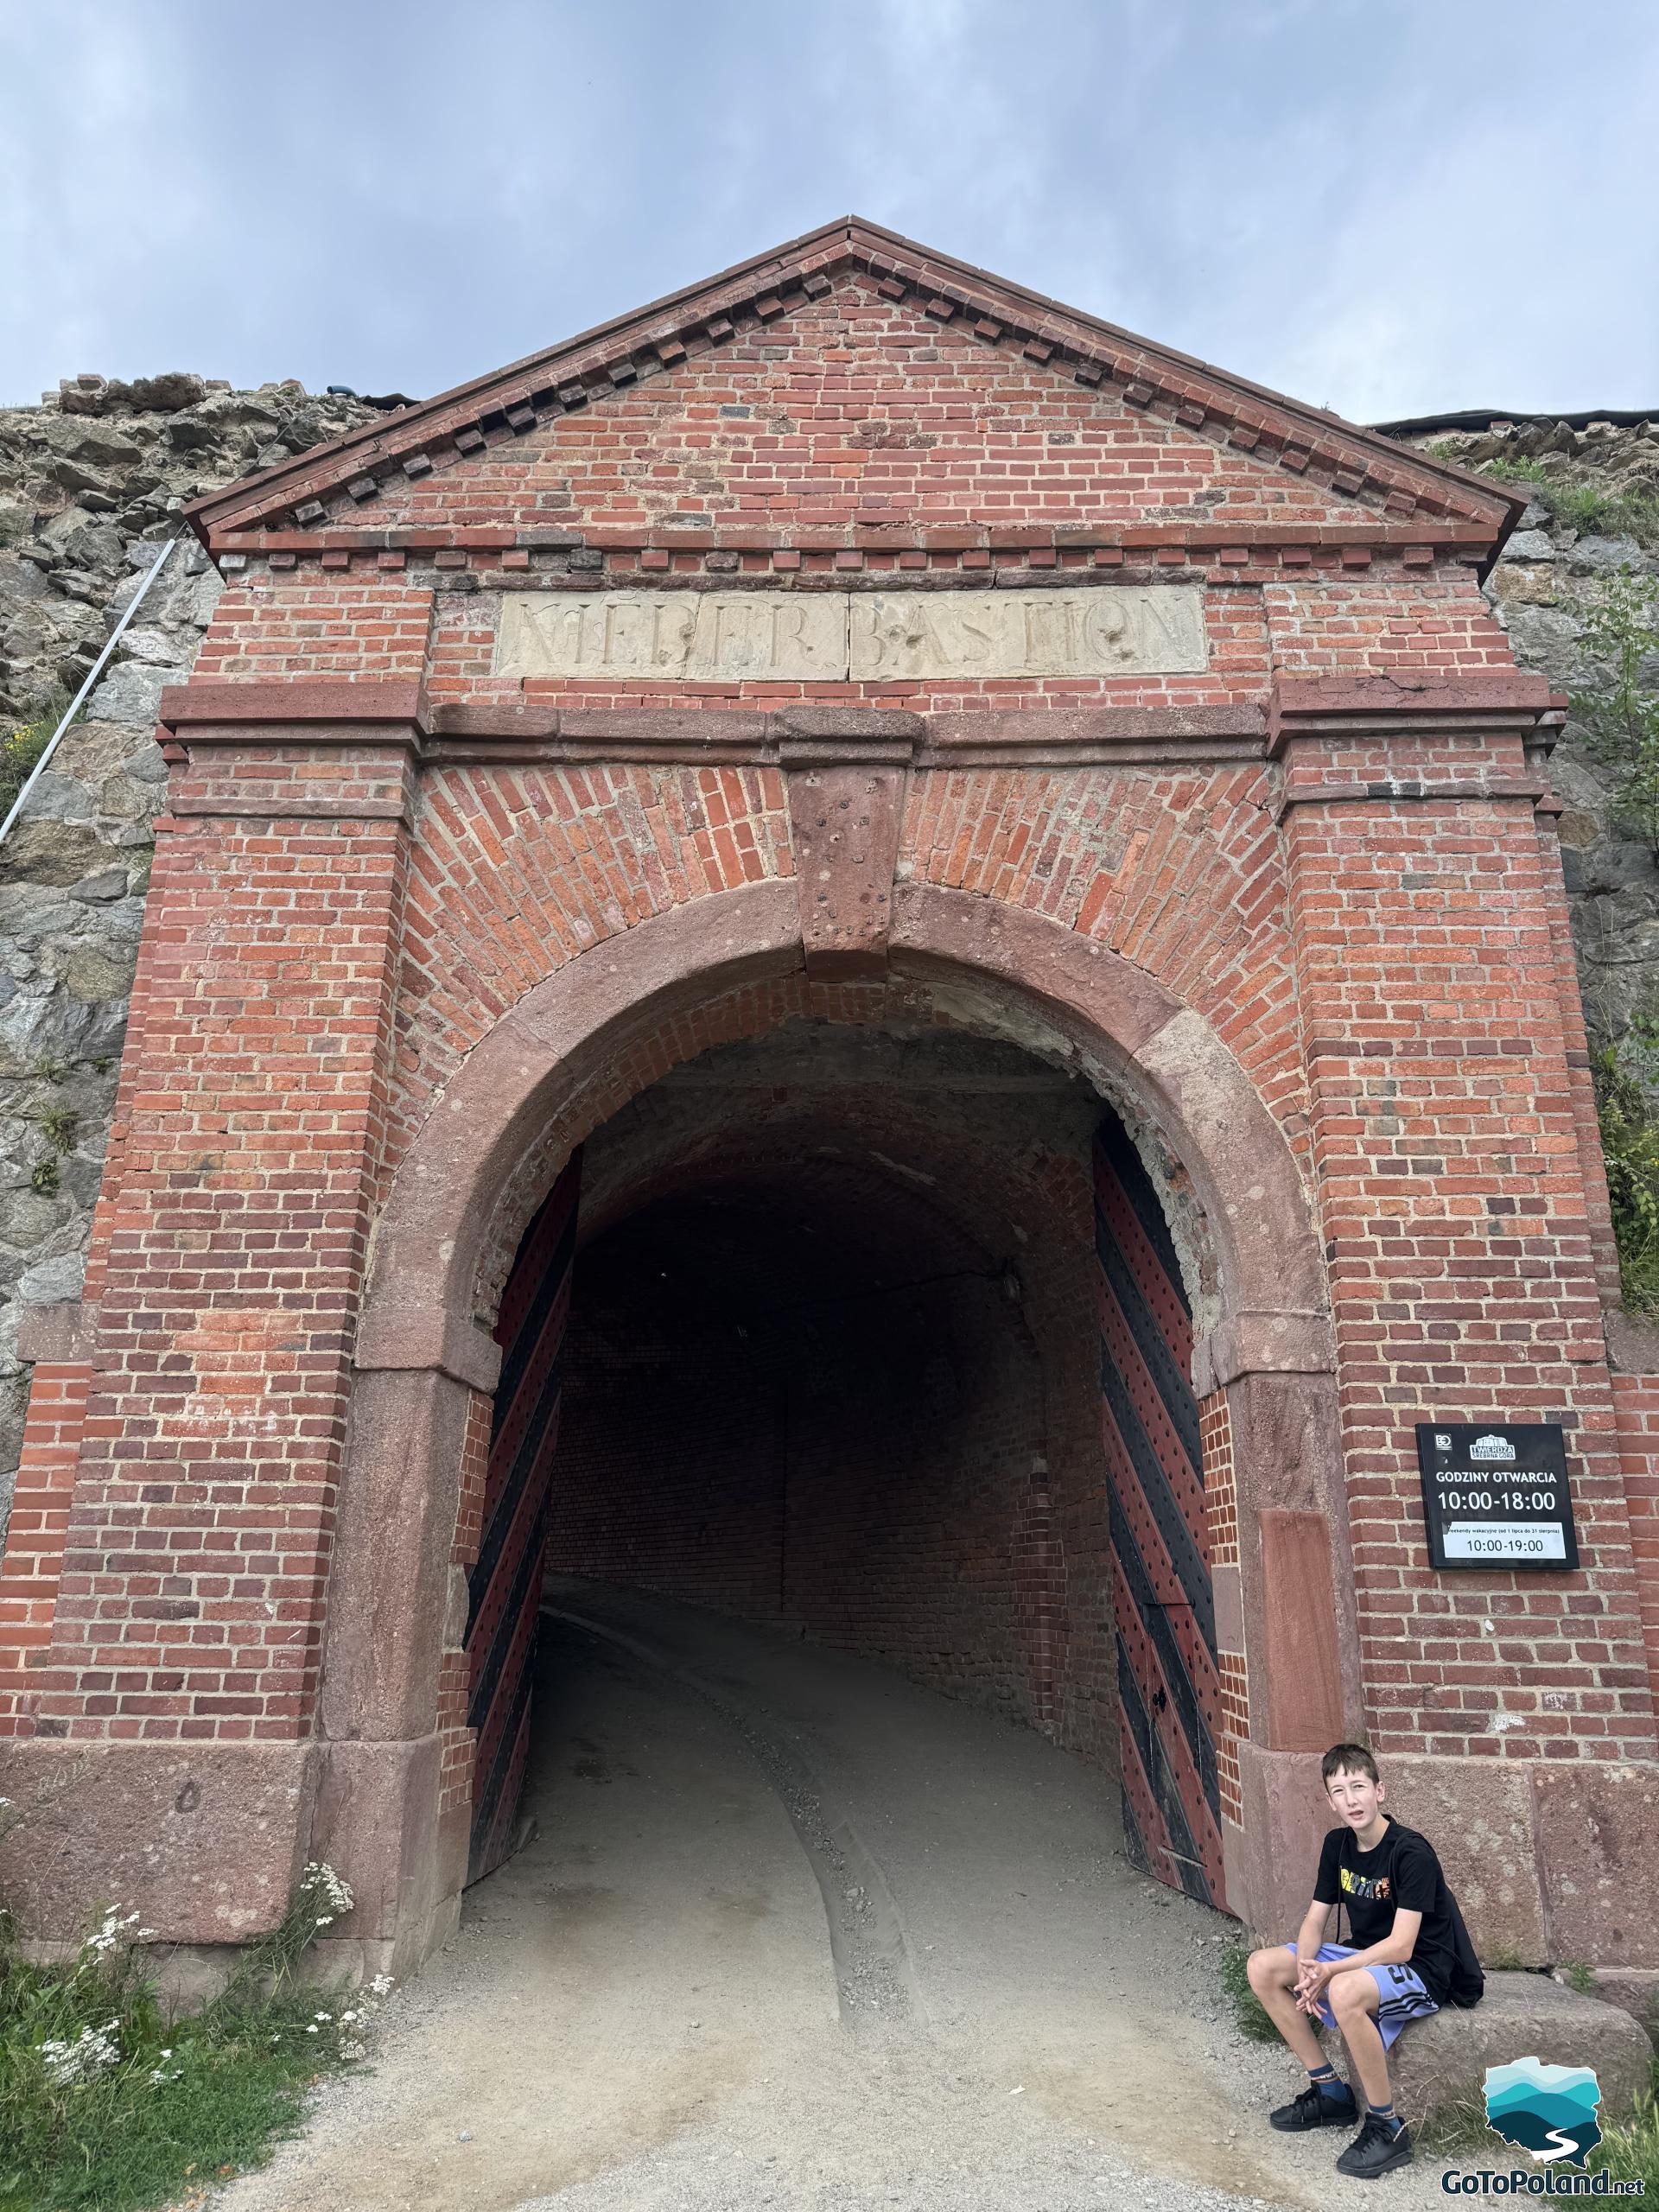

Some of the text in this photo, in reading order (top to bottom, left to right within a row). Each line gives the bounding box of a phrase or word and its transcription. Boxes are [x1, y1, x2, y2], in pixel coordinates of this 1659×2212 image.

[1436, 1471, 1557, 1484] GODZINY OTWARCIA
[1438, 1491, 1555, 1510] 10:00-18:00
[1467, 1540, 1543, 1552] 10:00-19:00
